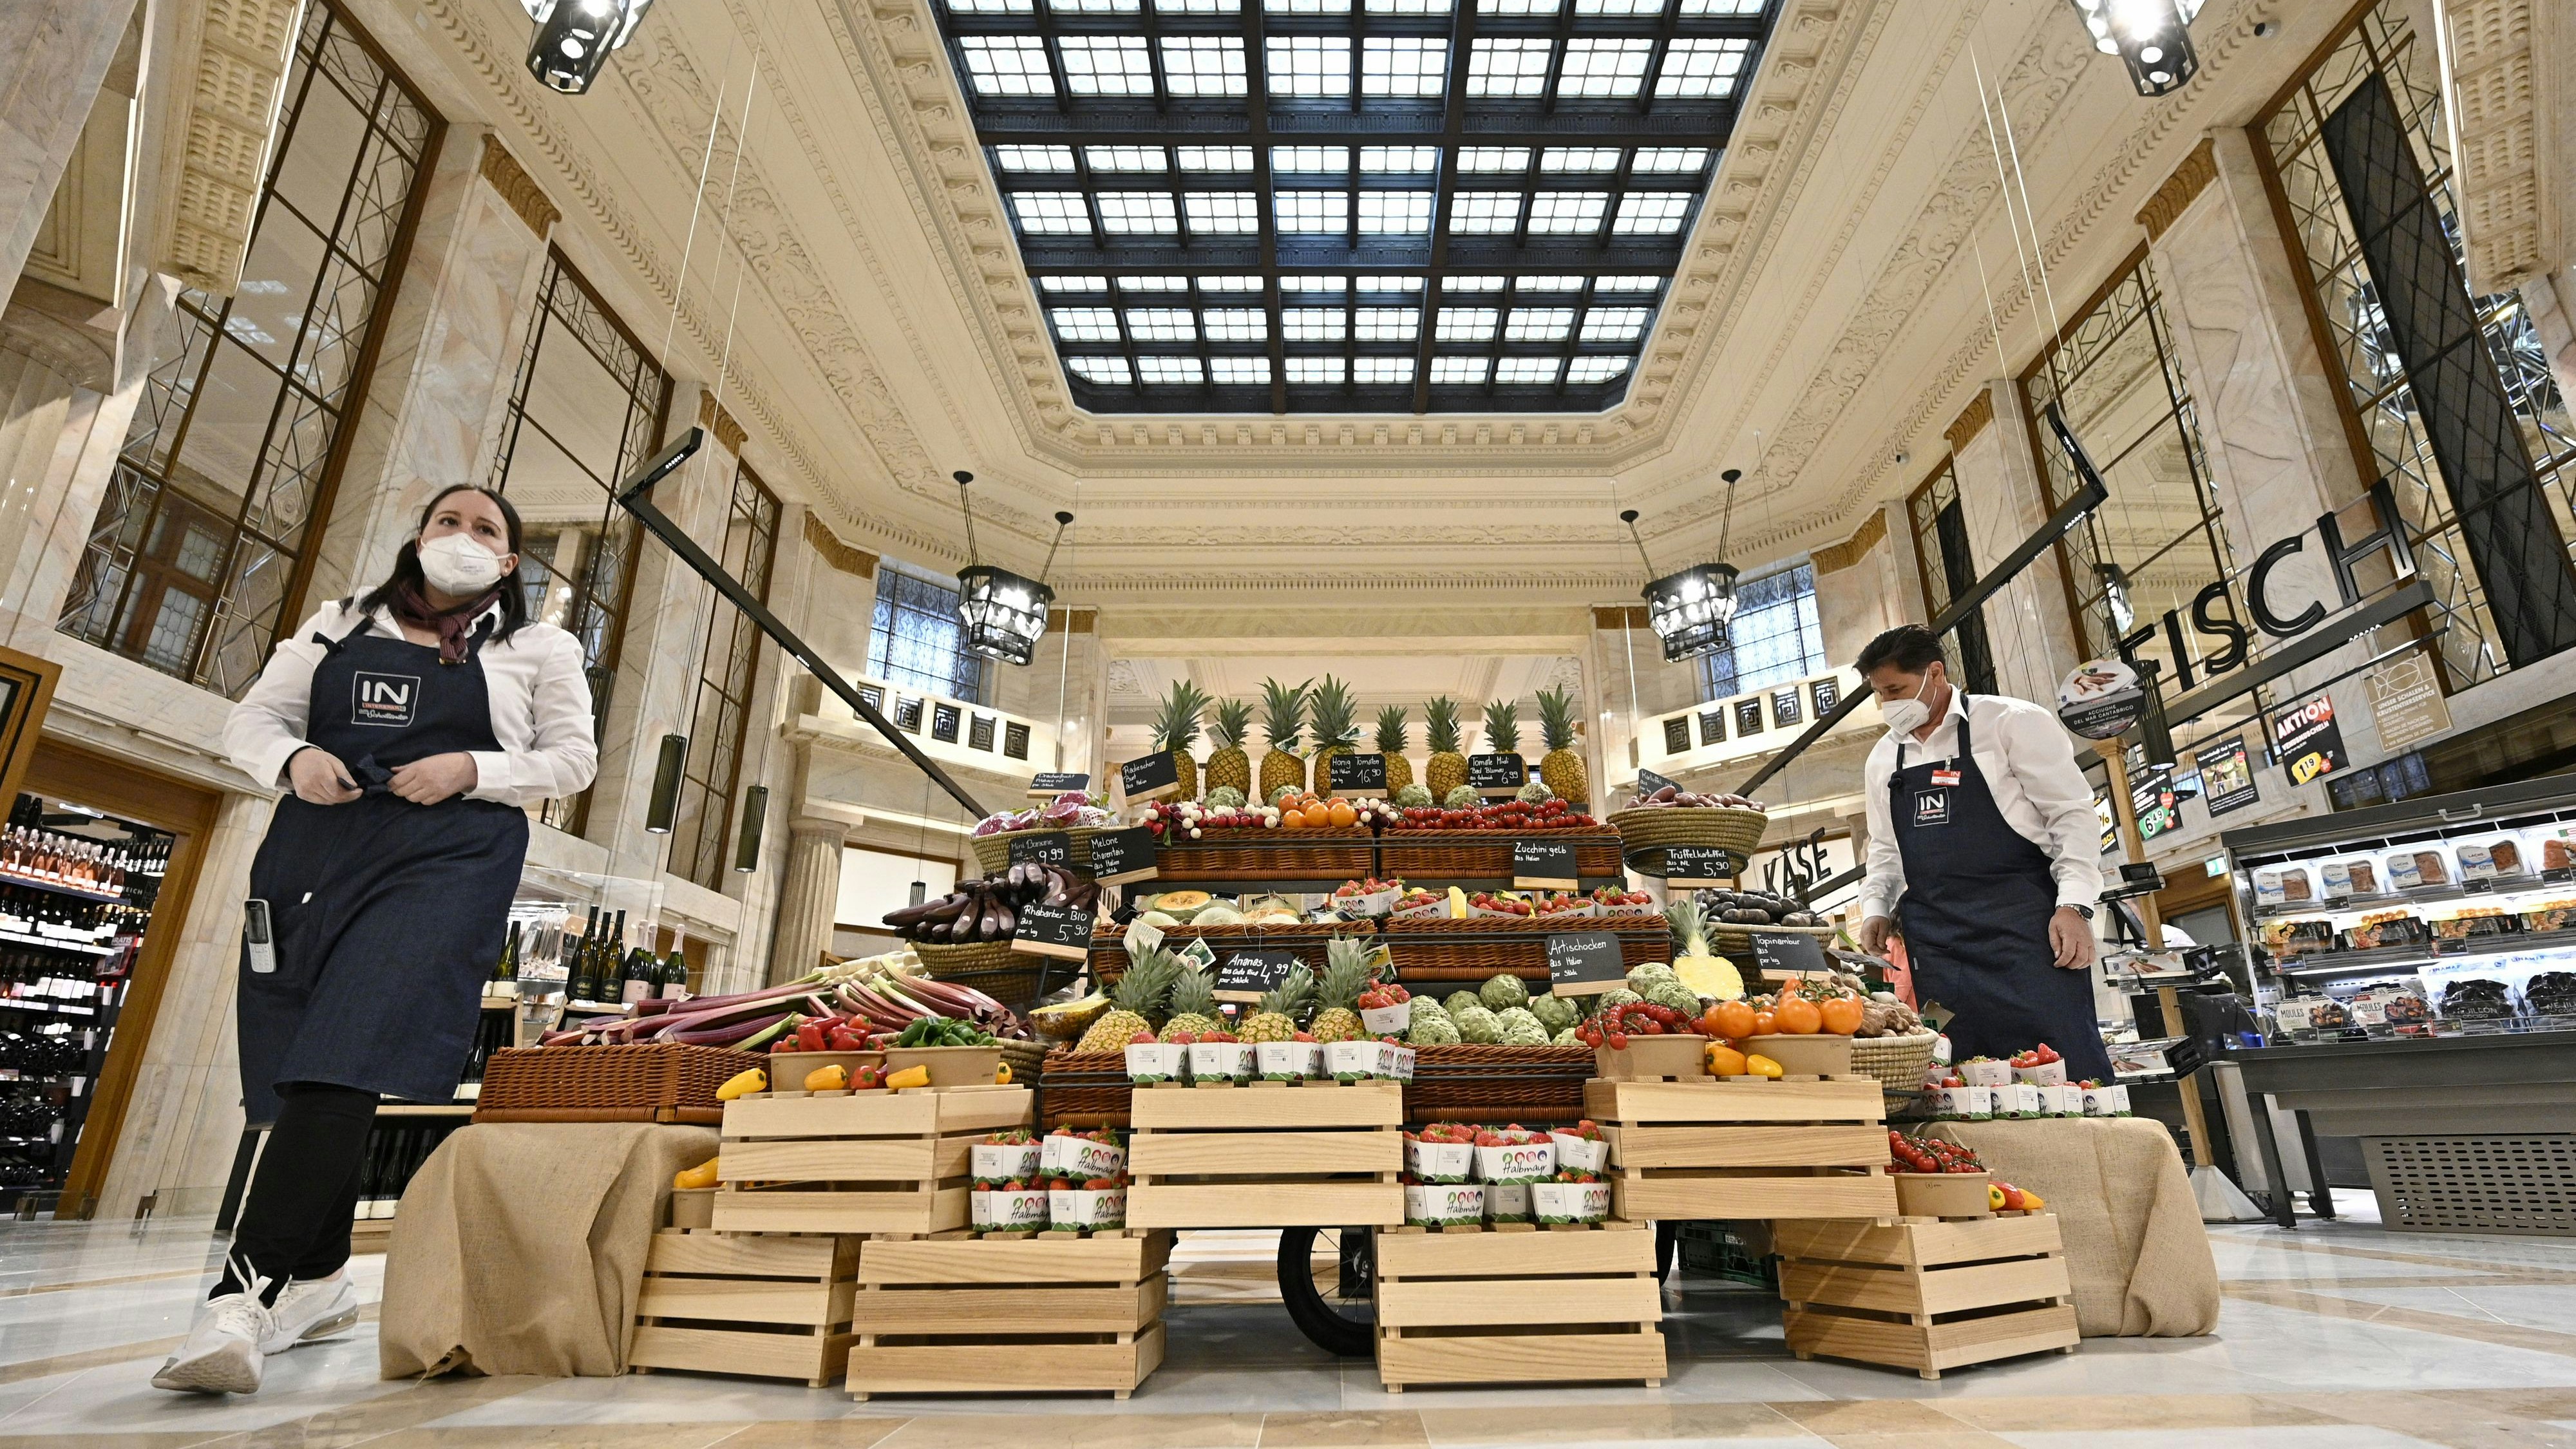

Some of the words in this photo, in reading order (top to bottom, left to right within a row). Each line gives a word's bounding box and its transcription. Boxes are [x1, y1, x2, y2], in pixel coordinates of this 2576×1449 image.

[362, 680, 409, 705] IN
[2397, 687, 2423, 702] SCHALEN
[2098, 705, 2134, 717] CANTABRICO
[2277, 697, 2331, 739] AKTION
[1122, 759, 1155, 775] Radieschen
[1332, 757, 1350, 770] Honig
[1355, 755, 1379, 766] Tomaten
[1471, 755, 1493, 766] Tomate
[1497, 756, 1510, 765] Midi
[1920, 793, 1944, 811] IN
[1026, 838, 1054, 849] Banane
[1091, 837, 1119, 849] Melone
[1515, 842, 1547, 853] Zucchini
[1549, 845, 1566, 857] gelb
[1092, 846, 1124, 860] Charentais
[1666, 848, 1727, 859] Trüffelkartoffel
[1763, 826, 1832, 898] KÄSE
[1024, 905, 1065, 918] Rhabarber
[1070, 911, 1088, 922] BIO
[1549, 938, 1607, 956] Artischocken
[1752, 934, 1800, 948] Topinambur
[1227, 953, 1263, 967] Ananas
[1550, 958, 1561, 967] aus
[1566, 956, 1582, 966] Italien
[1551, 972, 1560, 981] per
[2280, 1008, 2305, 1018] MOULES
[2356, 1002, 2383, 1012] MOULES
[1077, 1157, 1115, 1175] Halbmayr
[1502, 1161, 1548, 1177] Halbmayr
[1446, 1200, 1482, 1217] Halbmayr
